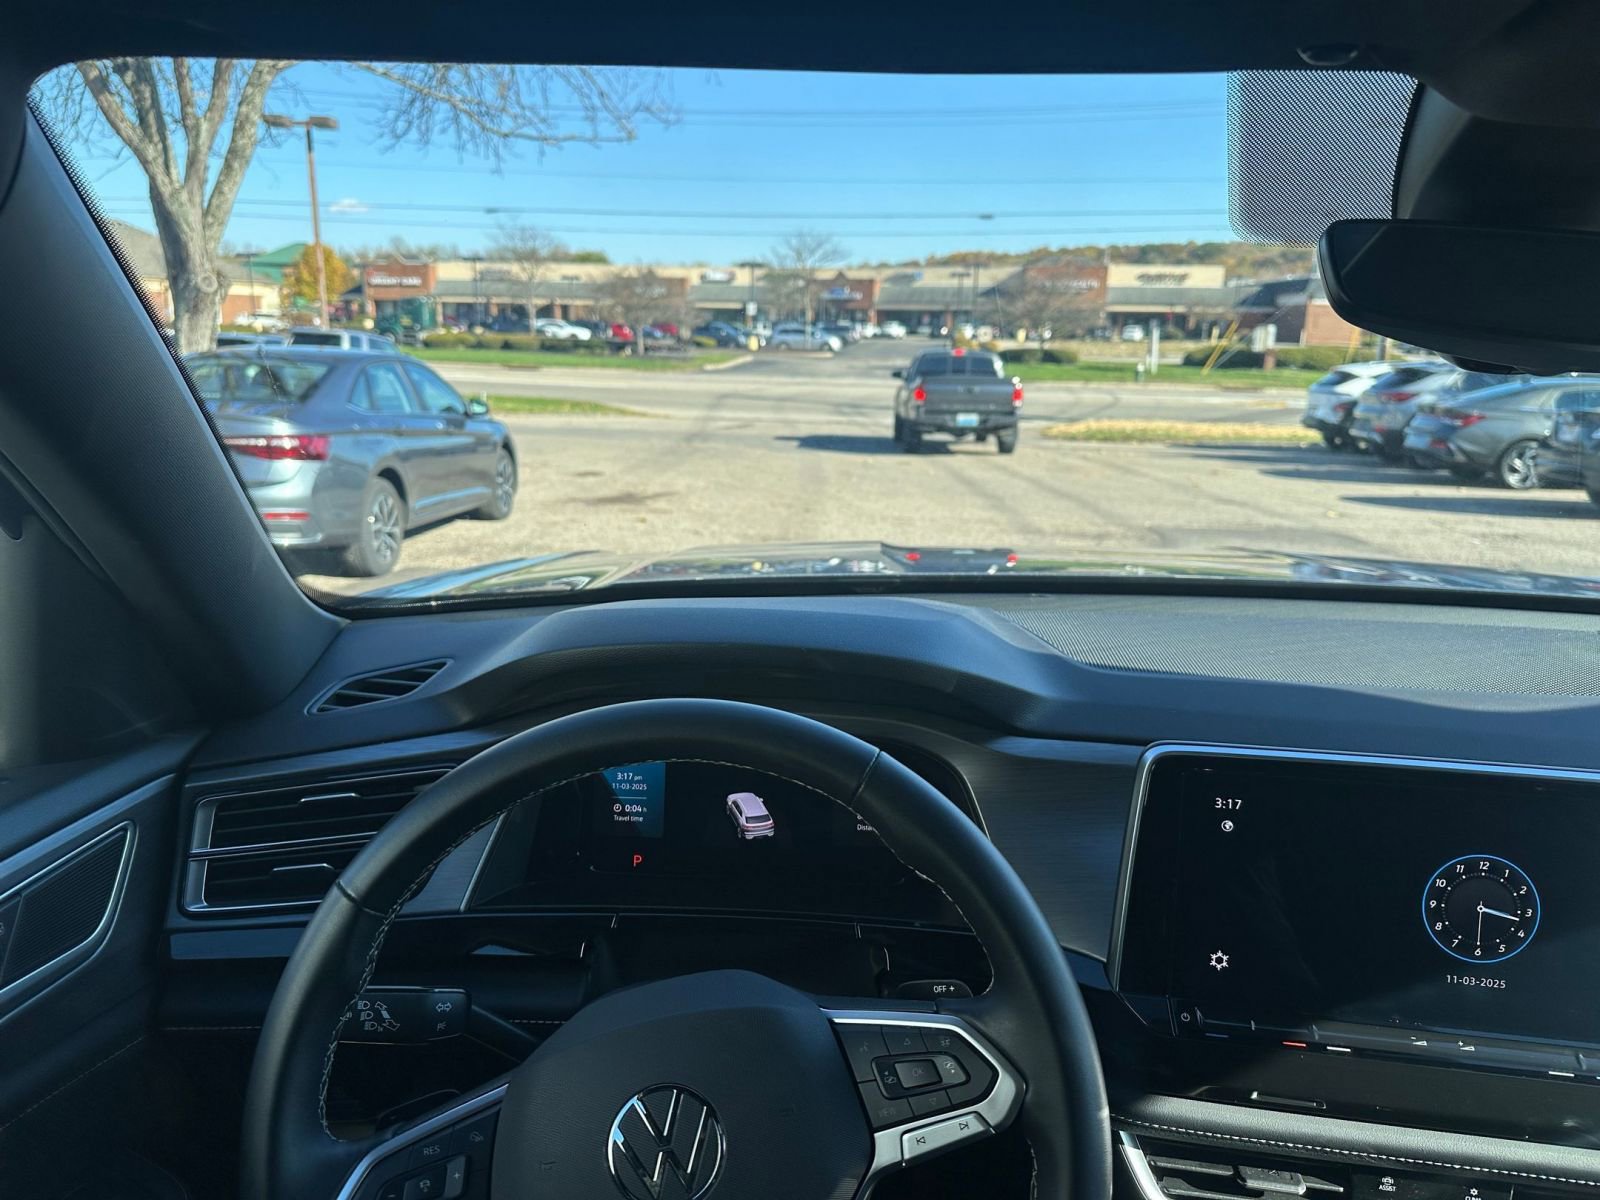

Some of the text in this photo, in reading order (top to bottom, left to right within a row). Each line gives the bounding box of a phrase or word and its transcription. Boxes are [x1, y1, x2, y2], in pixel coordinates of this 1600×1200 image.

[616, 772, 633, 780] 3:17
[625, 804, 642, 812] 0:04
[1215, 797, 1242, 810] 3:17
[633, 855, 642, 867] P
[1480, 861, 1490, 870] 12
[1456, 864, 1465, 873] 11
[1504, 869, 1510, 878] 1
[1435, 879, 1447, 888] 10
[1520, 886, 1527, 895] 2
[1429, 900, 1437, 909] 9
[1525, 908, 1533, 917] 3
[1434, 922, 1442, 931] 8
[1517, 929, 1525, 938] 4
[1451, 939, 1459, 948] 7
[1474, 948, 1482, 957] 6
[1498, 944, 1507, 953] 5
[1446, 974, 1507, 989] 11-03-2025
[933, 985, 947, 993] OFF
[423, 1145, 441, 1156] RES
[1378, 1184, 1396, 1192] ASSIST
